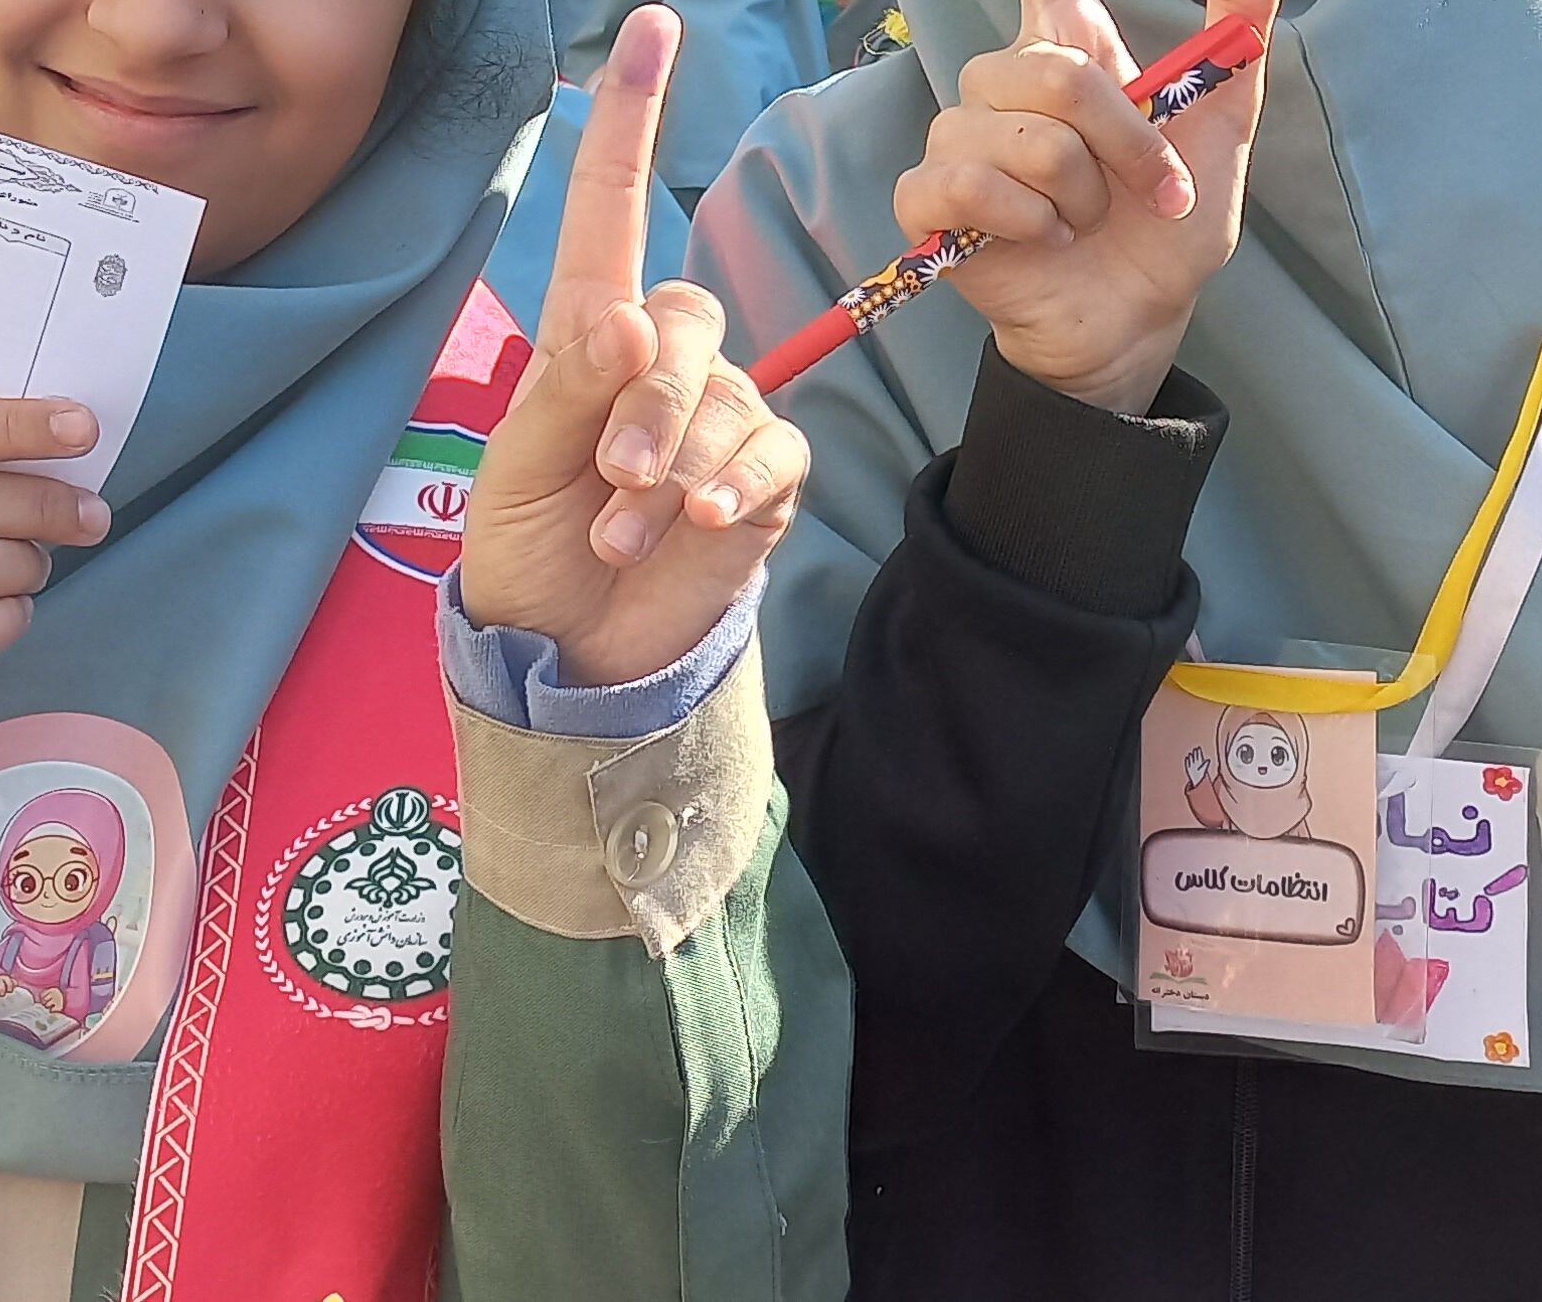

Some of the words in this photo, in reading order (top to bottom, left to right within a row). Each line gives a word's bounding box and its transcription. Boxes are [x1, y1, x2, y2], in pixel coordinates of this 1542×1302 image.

[23, 233, 46, 243] نام
[1385, 791, 1492, 856] نما
[1174, 865, 1230, 892] کلاس
[1230, 871, 1328, 902] انتظامات
[1375, 864, 1528, 935] کتاب
[336, 928, 377, 946] آموزی
[369, 924, 397, 947] دانش
